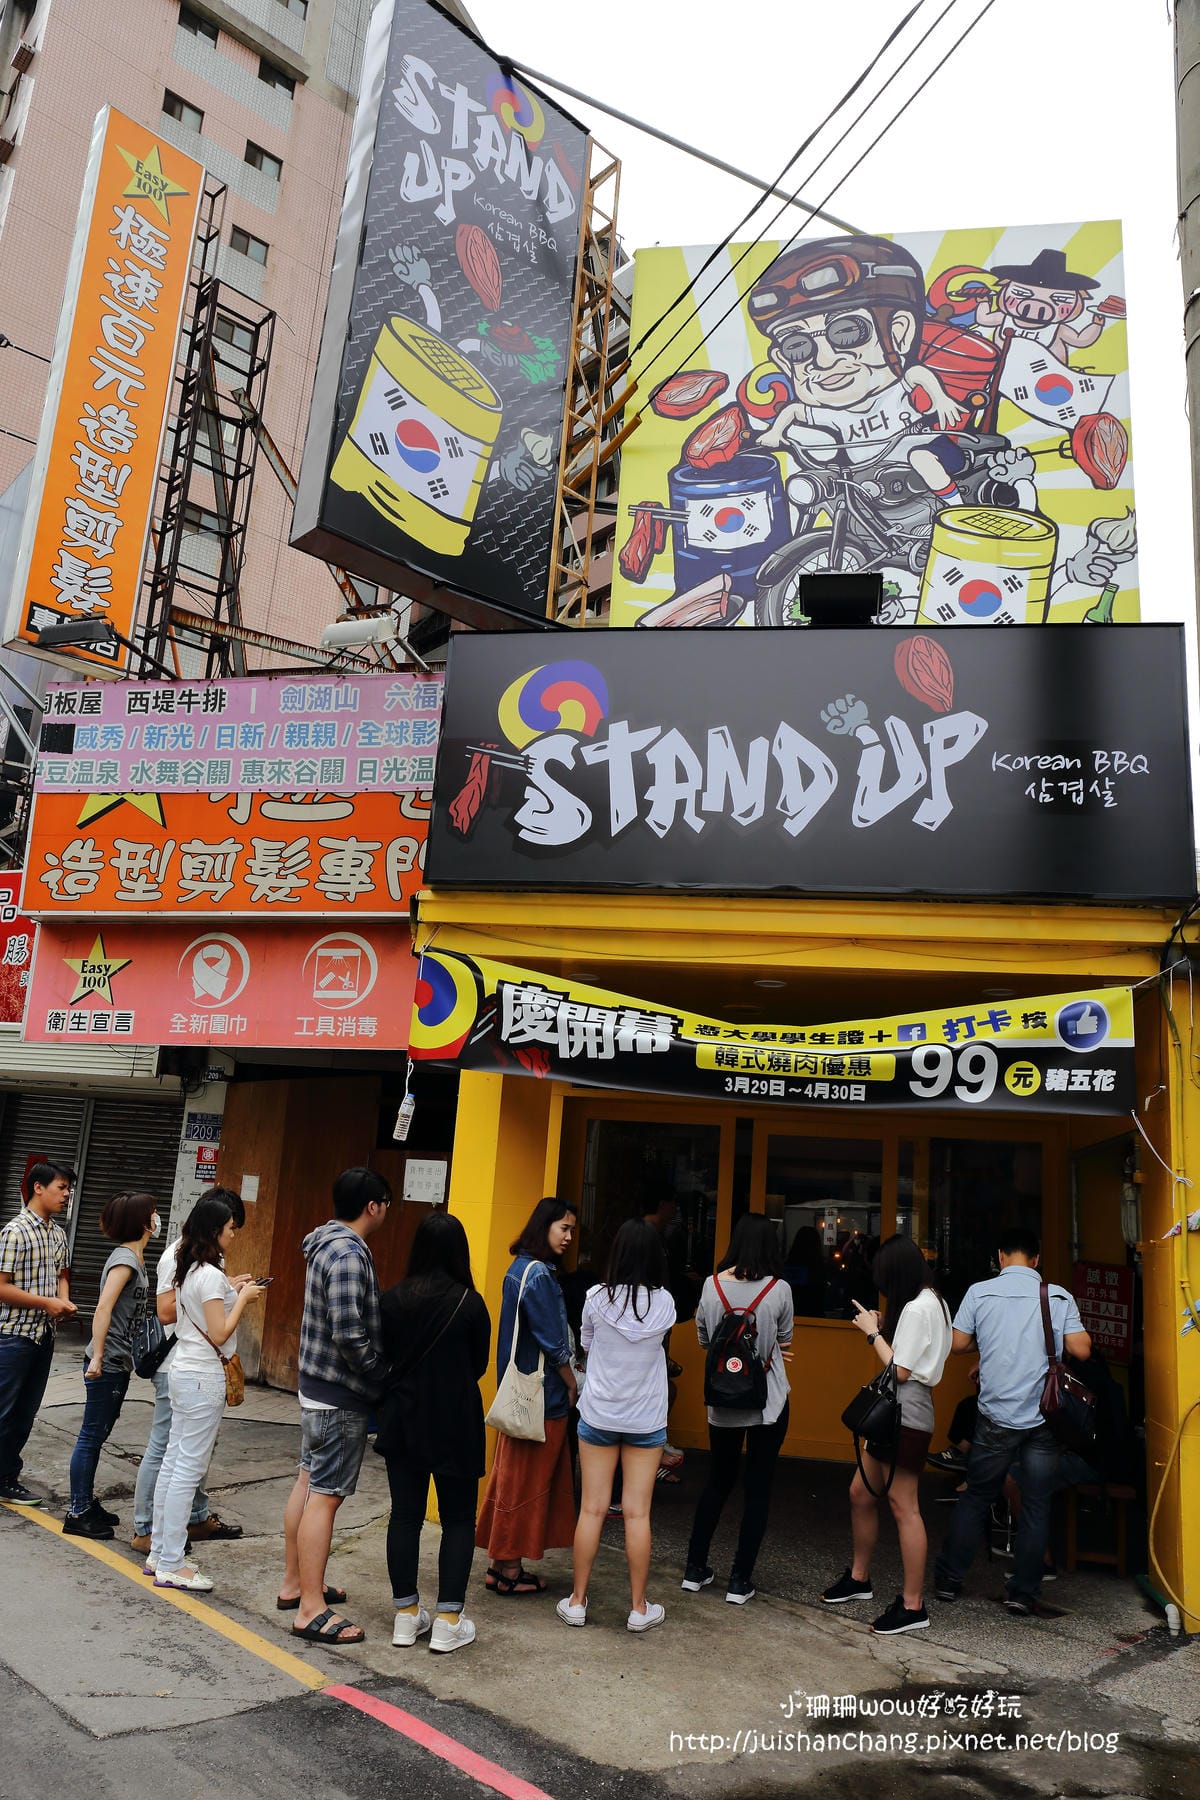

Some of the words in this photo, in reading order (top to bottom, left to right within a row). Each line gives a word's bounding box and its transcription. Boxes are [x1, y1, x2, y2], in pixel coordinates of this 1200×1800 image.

[392, 54, 577, 223] STAND
[135, 160, 168, 191] Easy
[136, 177, 163, 201] 100
[400, 140, 475, 226] UP
[473, 192, 522, 229] Korean
[528, 222, 557, 252] BBQ
[487, 222, 539, 263] 삼겹살
[49, 203, 172, 614] 極速百元造型剪髮
[847, 418, 890, 443] 서다
[127, 688, 226, 714] 西堤牛排
[281, 684, 359, 711] 劍湖山
[384, 683, 444, 710] 六福
[130, 759, 230, 785] 水舞谷關
[241, 758, 344, 785] 惠來谷關
[991, 751, 1081, 772] Korean
[1092, 750, 1150, 774] BBQ
[513, 719, 836, 846] STAND
[851, 711, 989, 831] UP
[1025, 777, 1118, 808] 삼겹살
[80, 960, 111, 976] Easy
[82, 976, 107, 989] 100
[48, 1012, 133, 1032] 衛生宣言
[169, 1013, 248, 1035] 全新圍巾
[294, 1016, 378, 1038] 工具消毒
[501, 983, 680, 1060] 慶開幕
[942, 1010, 1012, 1042] 打卡
[1021, 1011, 1048, 1029] 按
[715, 1047, 872, 1076] 韓式燒肉優惠
[909, 1044, 998, 1103] 99
[1011, 1067, 1034, 1089] 元
